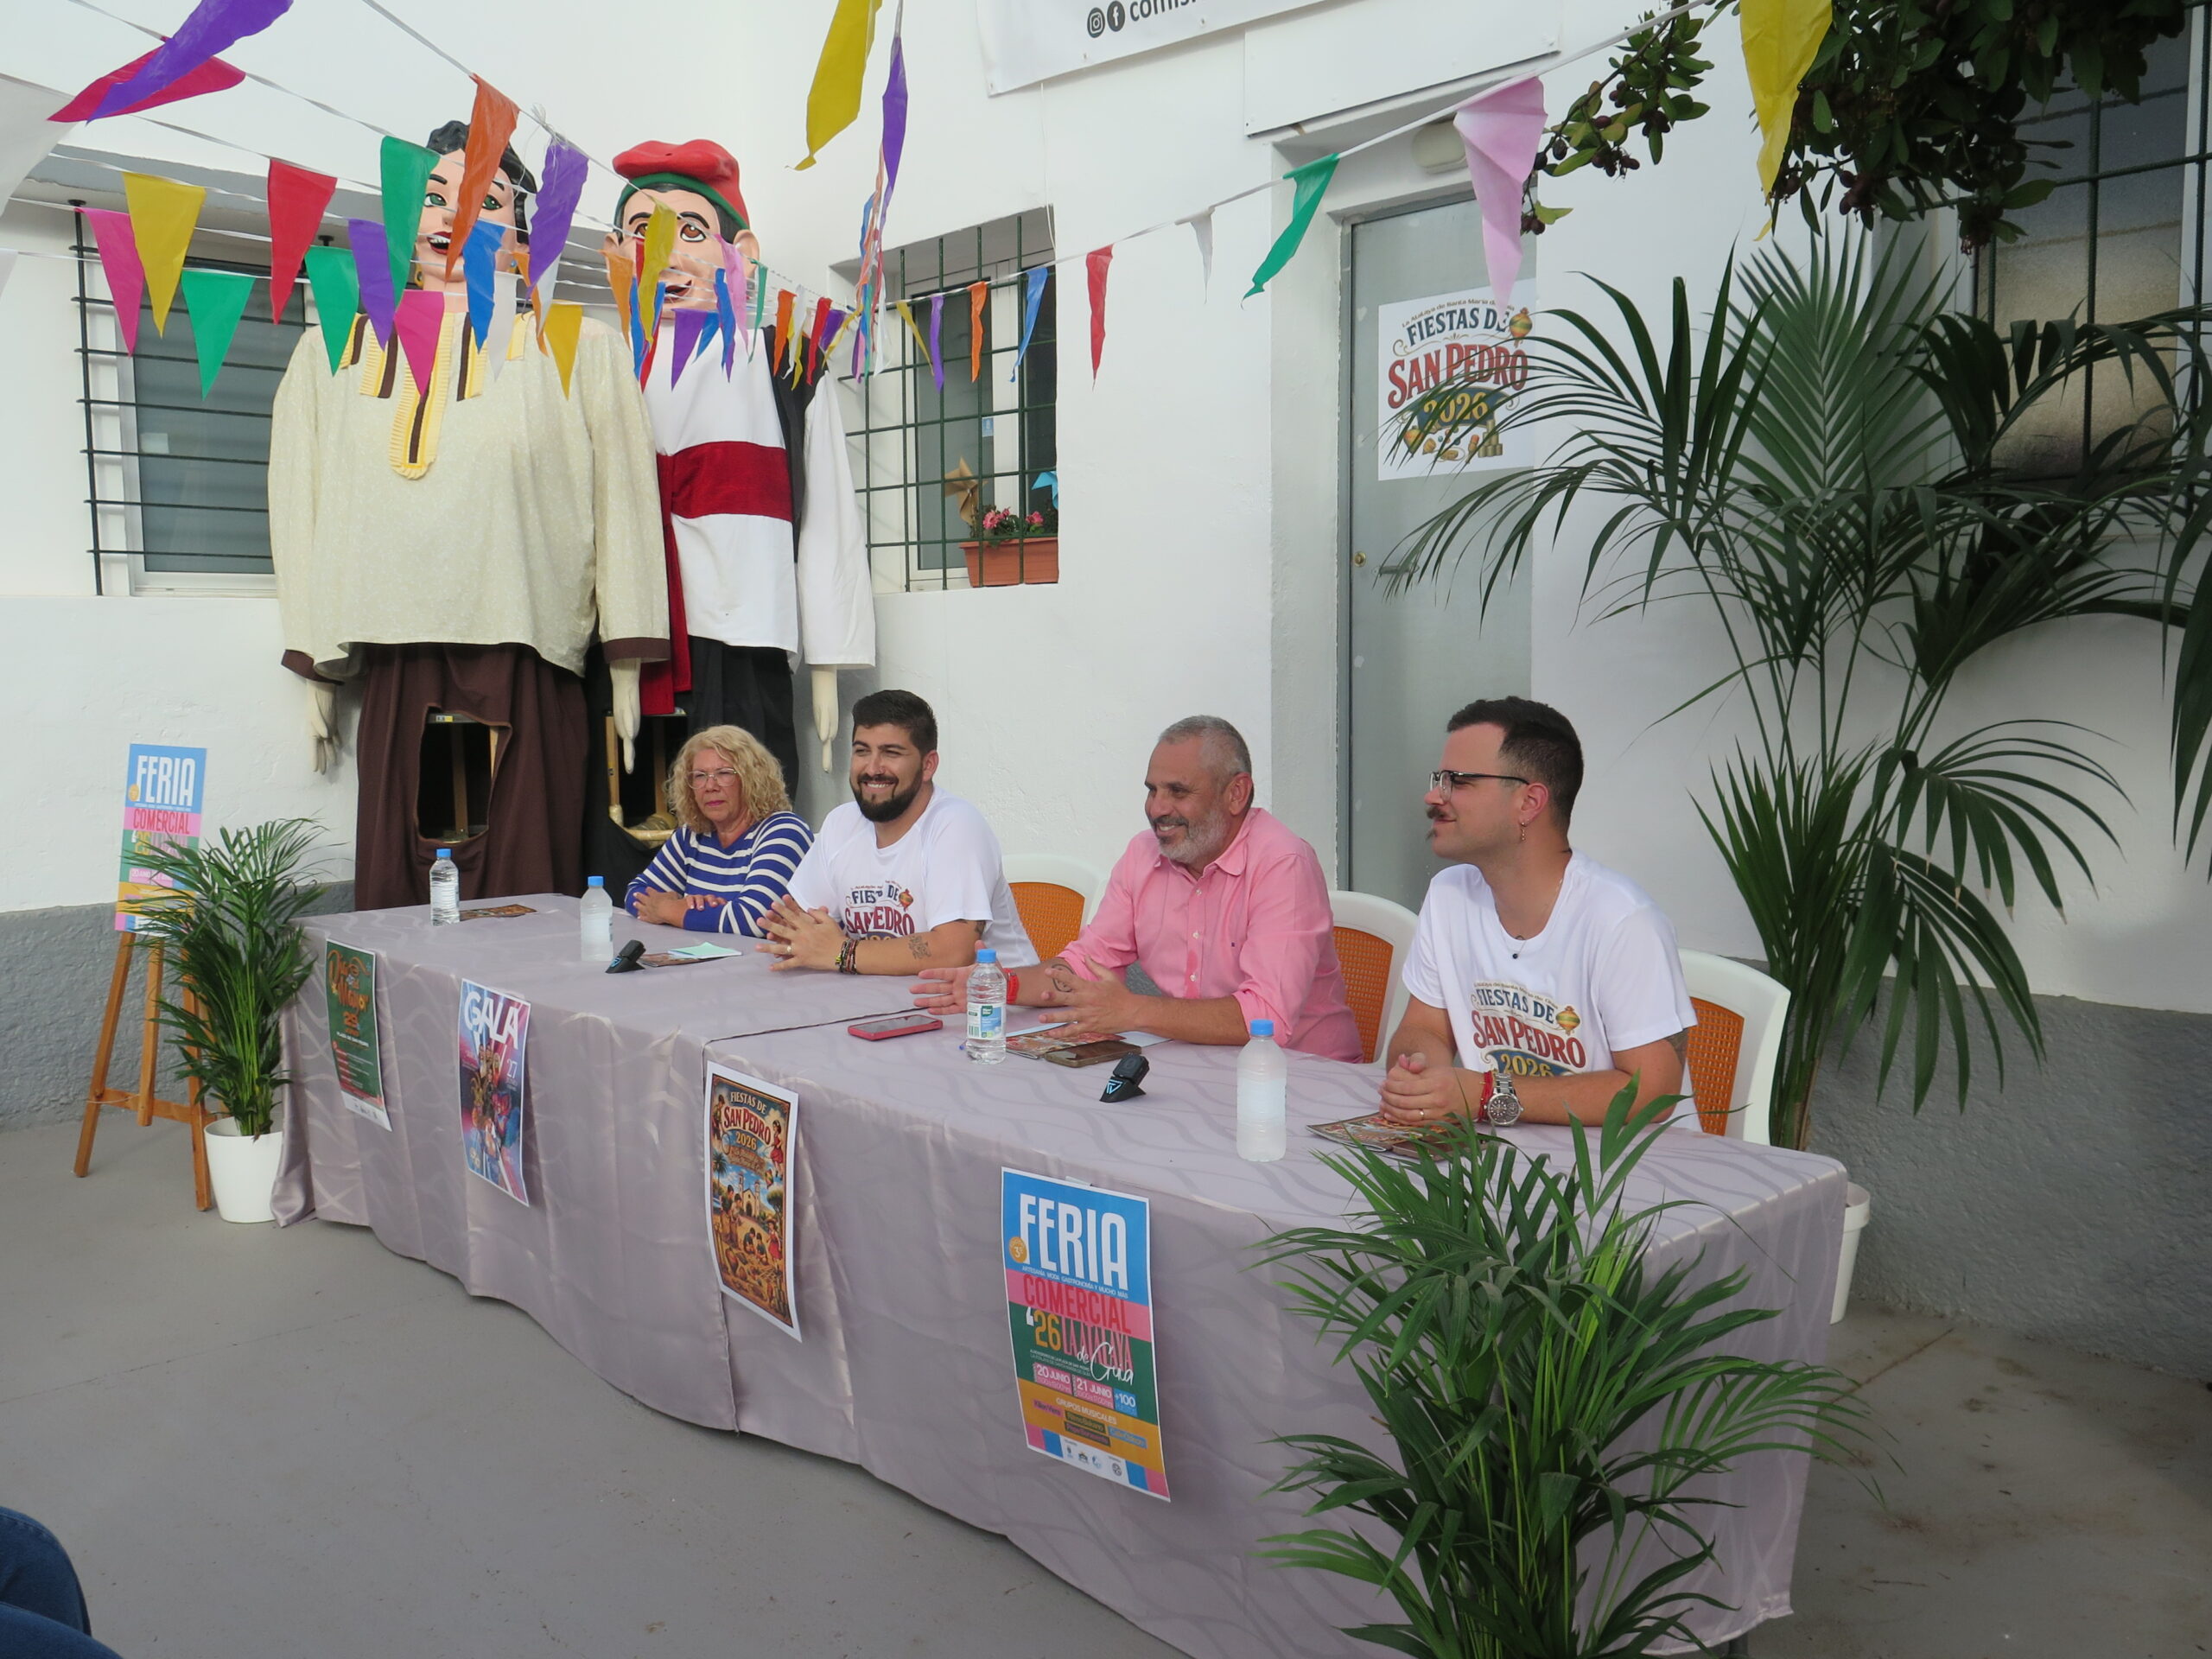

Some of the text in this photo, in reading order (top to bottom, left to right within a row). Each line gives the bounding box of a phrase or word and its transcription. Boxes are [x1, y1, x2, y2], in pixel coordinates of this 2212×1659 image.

[1406, 308, 1479, 346] FIESTAS
[1388, 343, 1528, 409] SAN PEDRO
[137, 754, 195, 806] FERIA
[133, 808, 190, 835] COMERCIAL
[887, 885, 899, 901] DE
[874, 906, 915, 936] EDRO
[464, 991, 518, 1050] GALA
[1476, 988, 1529, 1014] FIESTAS
[1533, 1001, 1554, 1024] DE
[1471, 1010, 1586, 1068] SAN PEDRO
[507, 1058, 518, 1078] 27
[1501, 1053, 1554, 1077] 2026
[730, 1091, 767, 1115] FIESTAS DE
[724, 1106, 771, 1146] SAN PEDRO
[735, 1131, 757, 1150] 2026
[1020, 1193, 1128, 1291] FERIA
[1023, 1273, 1132, 1334] COMERCIAL
[1062, 1316, 1078, 1357] LA
[1079, 1321, 1134, 1372] ATALAYA
[1077, 1344, 1089, 1363] de
[1036, 1364, 1049, 1378] 20
[1050, 1370, 1071, 1384] JUNIO
[1056, 1397, 1081, 1412] GRUPOS
[1077, 1377, 1088, 1391] 21
[1090, 1384, 1112, 1398] JUNIO
[1114, 1392, 1136, 1408] +100
